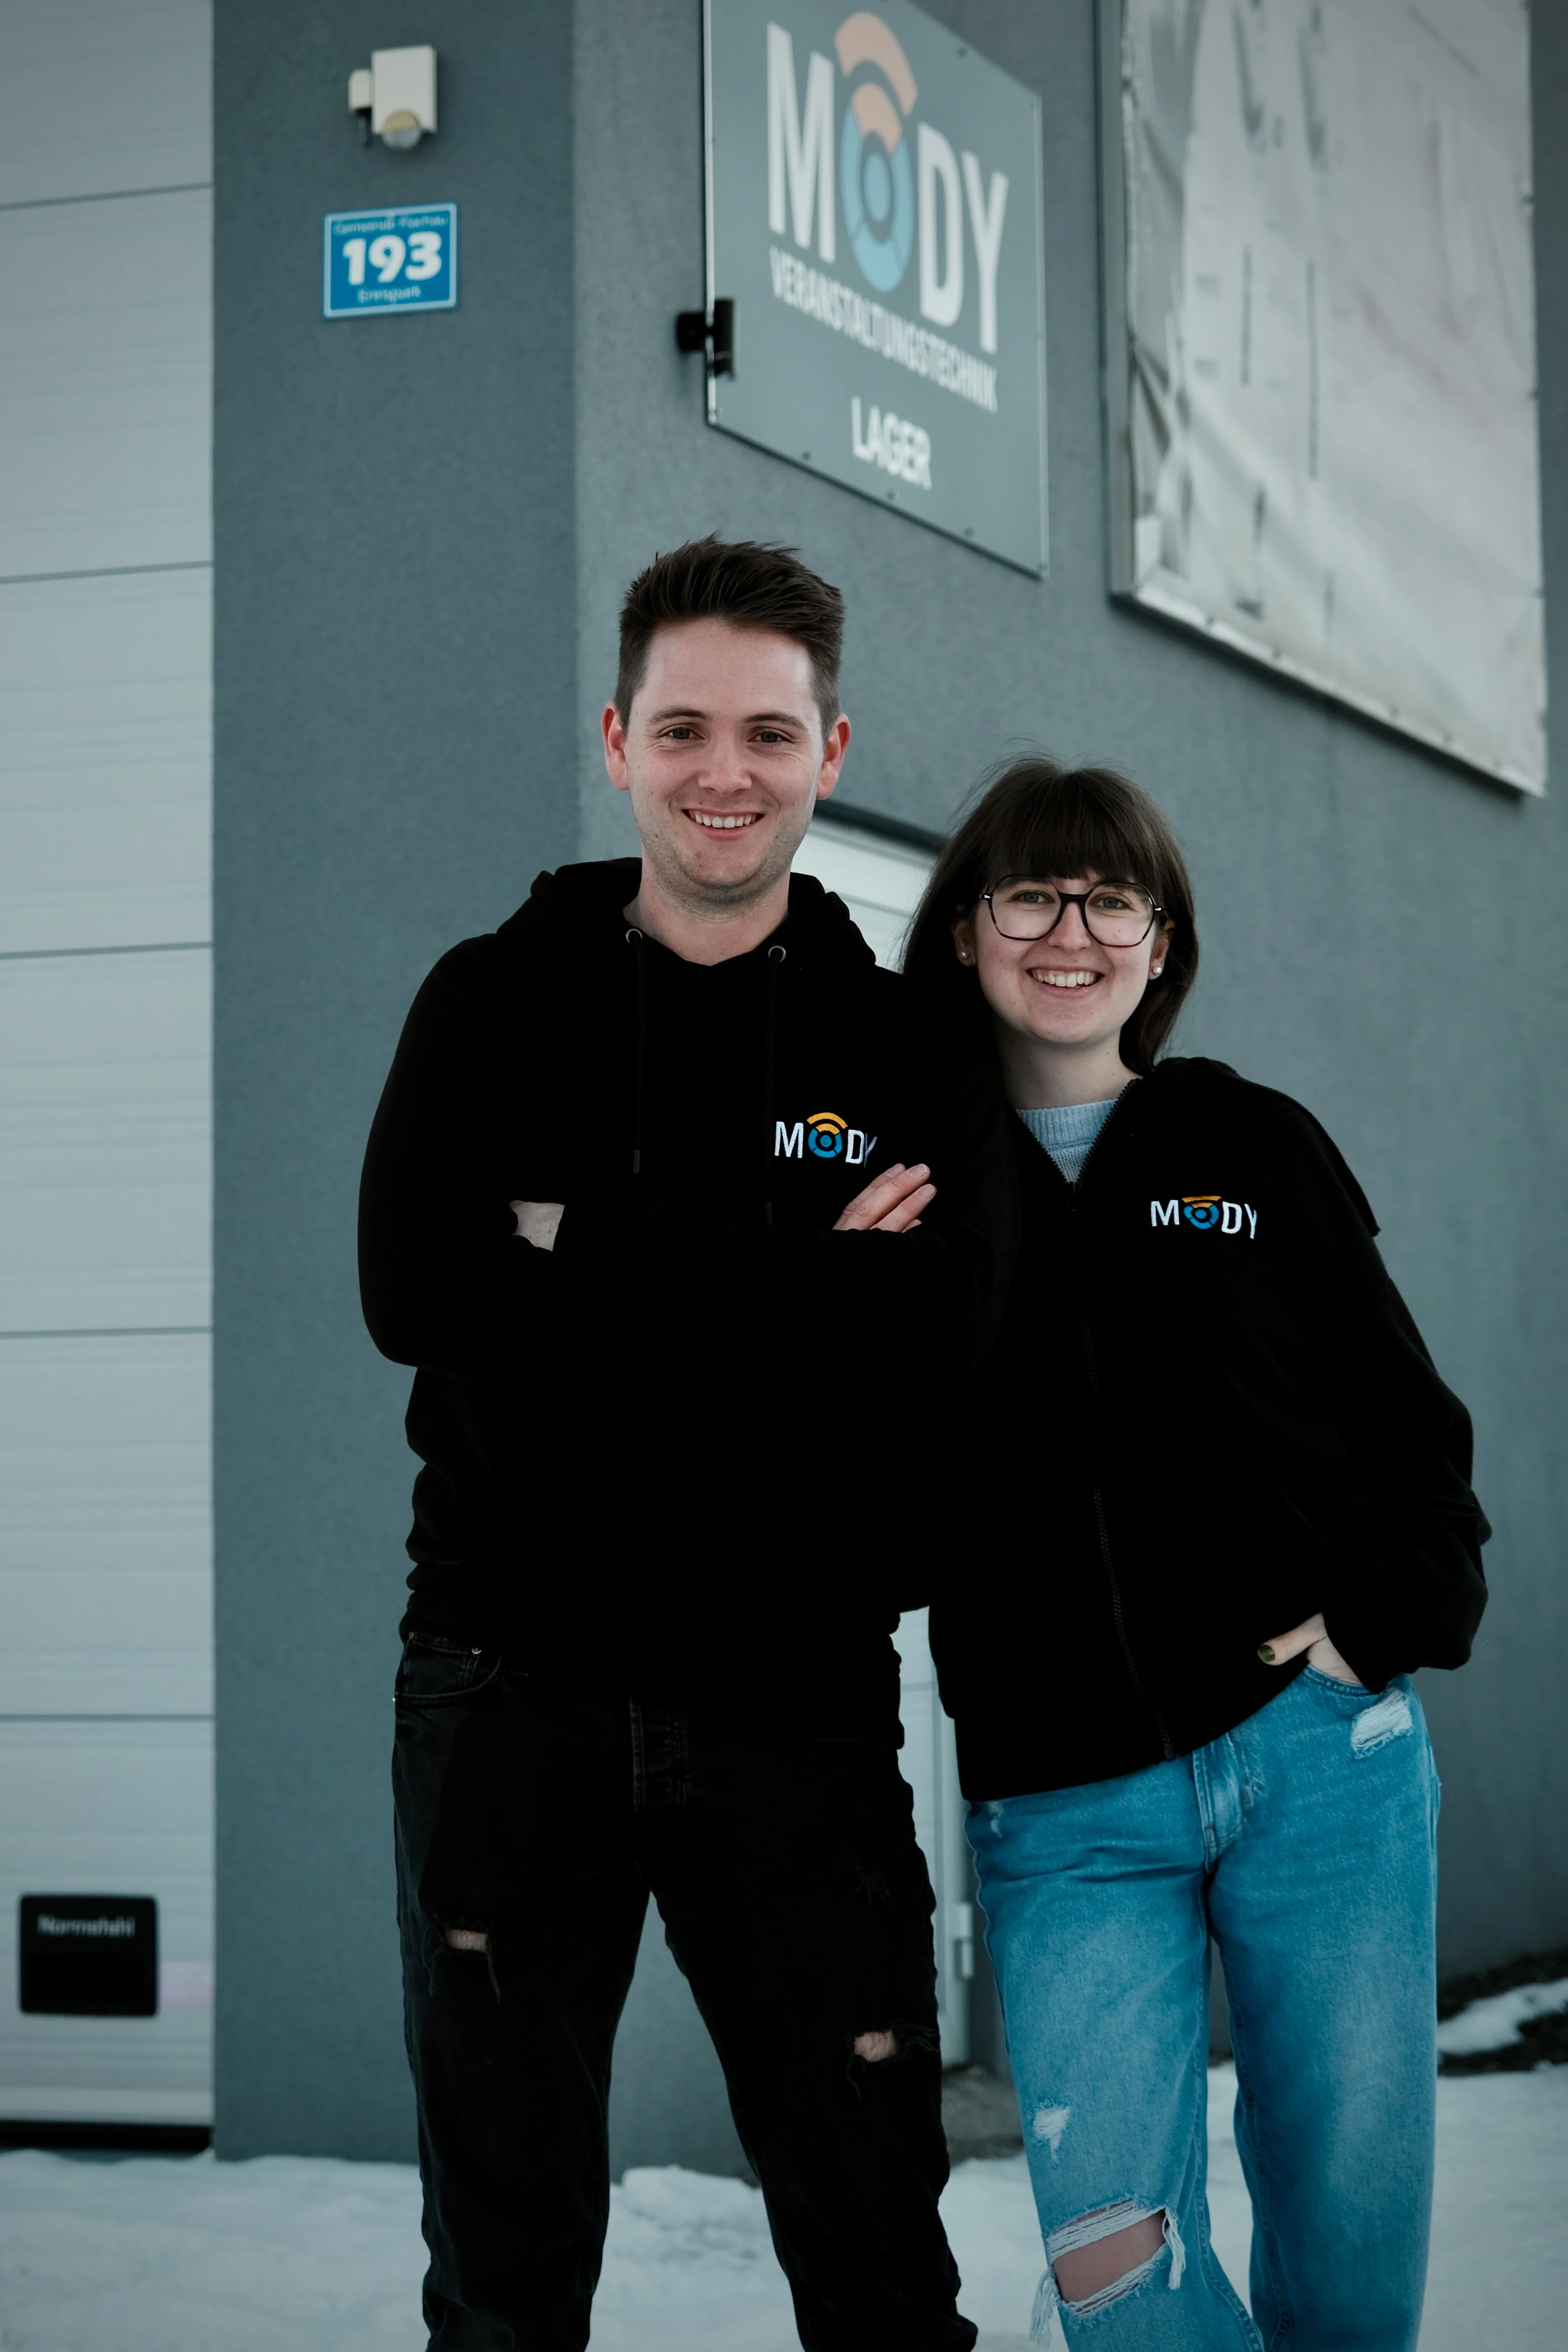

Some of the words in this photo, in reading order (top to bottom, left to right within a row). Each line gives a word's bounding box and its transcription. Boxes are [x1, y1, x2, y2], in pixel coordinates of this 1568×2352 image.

[767, 12, 1008, 355] MODY
[343, 231, 442, 286] 193
[770, 246, 998, 413] VERANSTALTUNGSTECHNIK
[851, 395, 932, 490] LAGER
[1150, 1195, 1257, 1239] MODY
